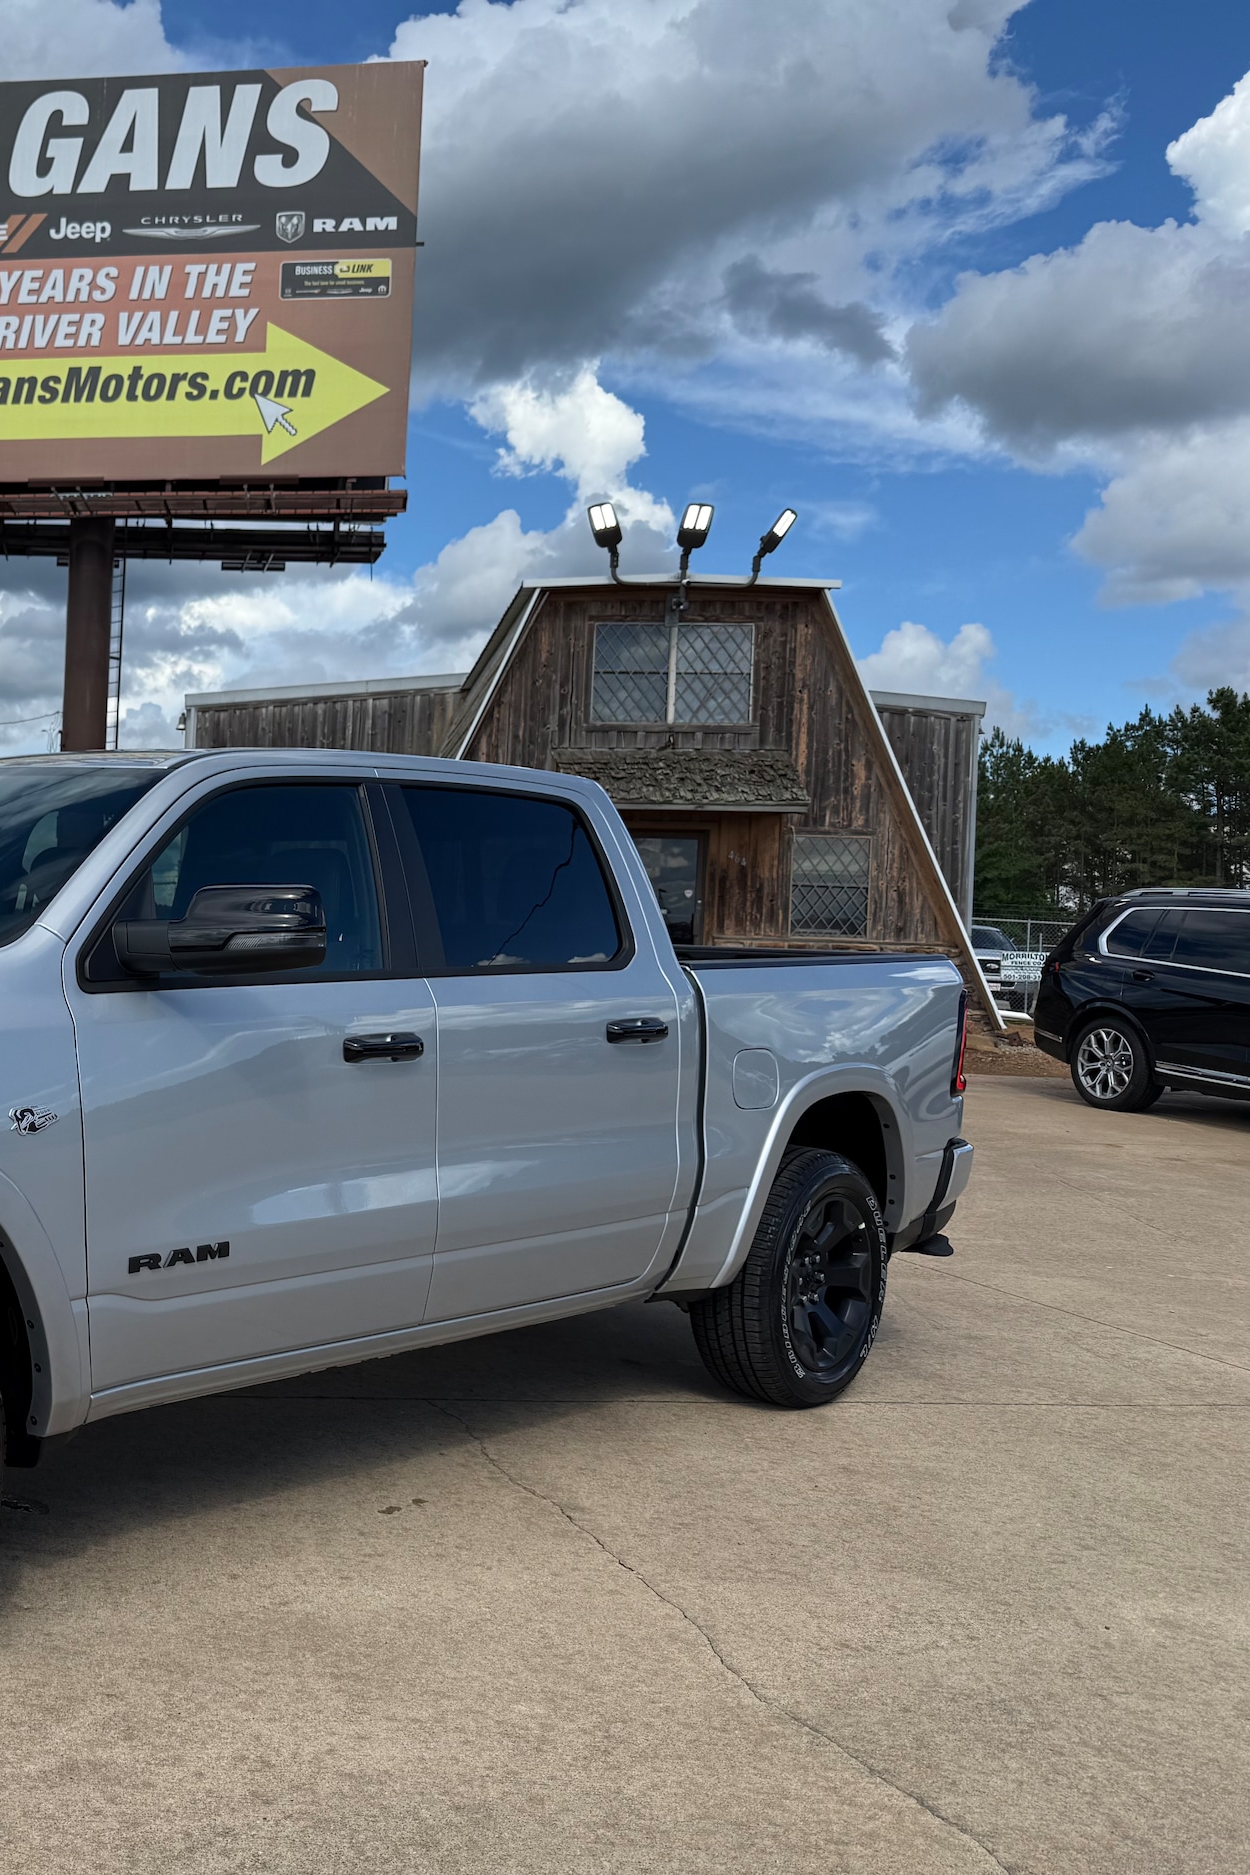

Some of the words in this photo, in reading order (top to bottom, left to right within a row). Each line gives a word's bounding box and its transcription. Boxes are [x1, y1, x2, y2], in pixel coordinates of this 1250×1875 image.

[49, 217, 111, 243] Jeep
[141, 214, 243, 225] CHRYSLER
[313, 216, 398, 233] RAM
[295, 265, 333, 276] BUSINESS
[351, 264, 374, 274] LINK
[0, 266, 119, 305] YEARS
[129, 265, 173, 301] IN
[184, 262, 256, 299] THE
[117, 308, 260, 346] VALLEY
[128, 1241, 230, 1274] RAM
